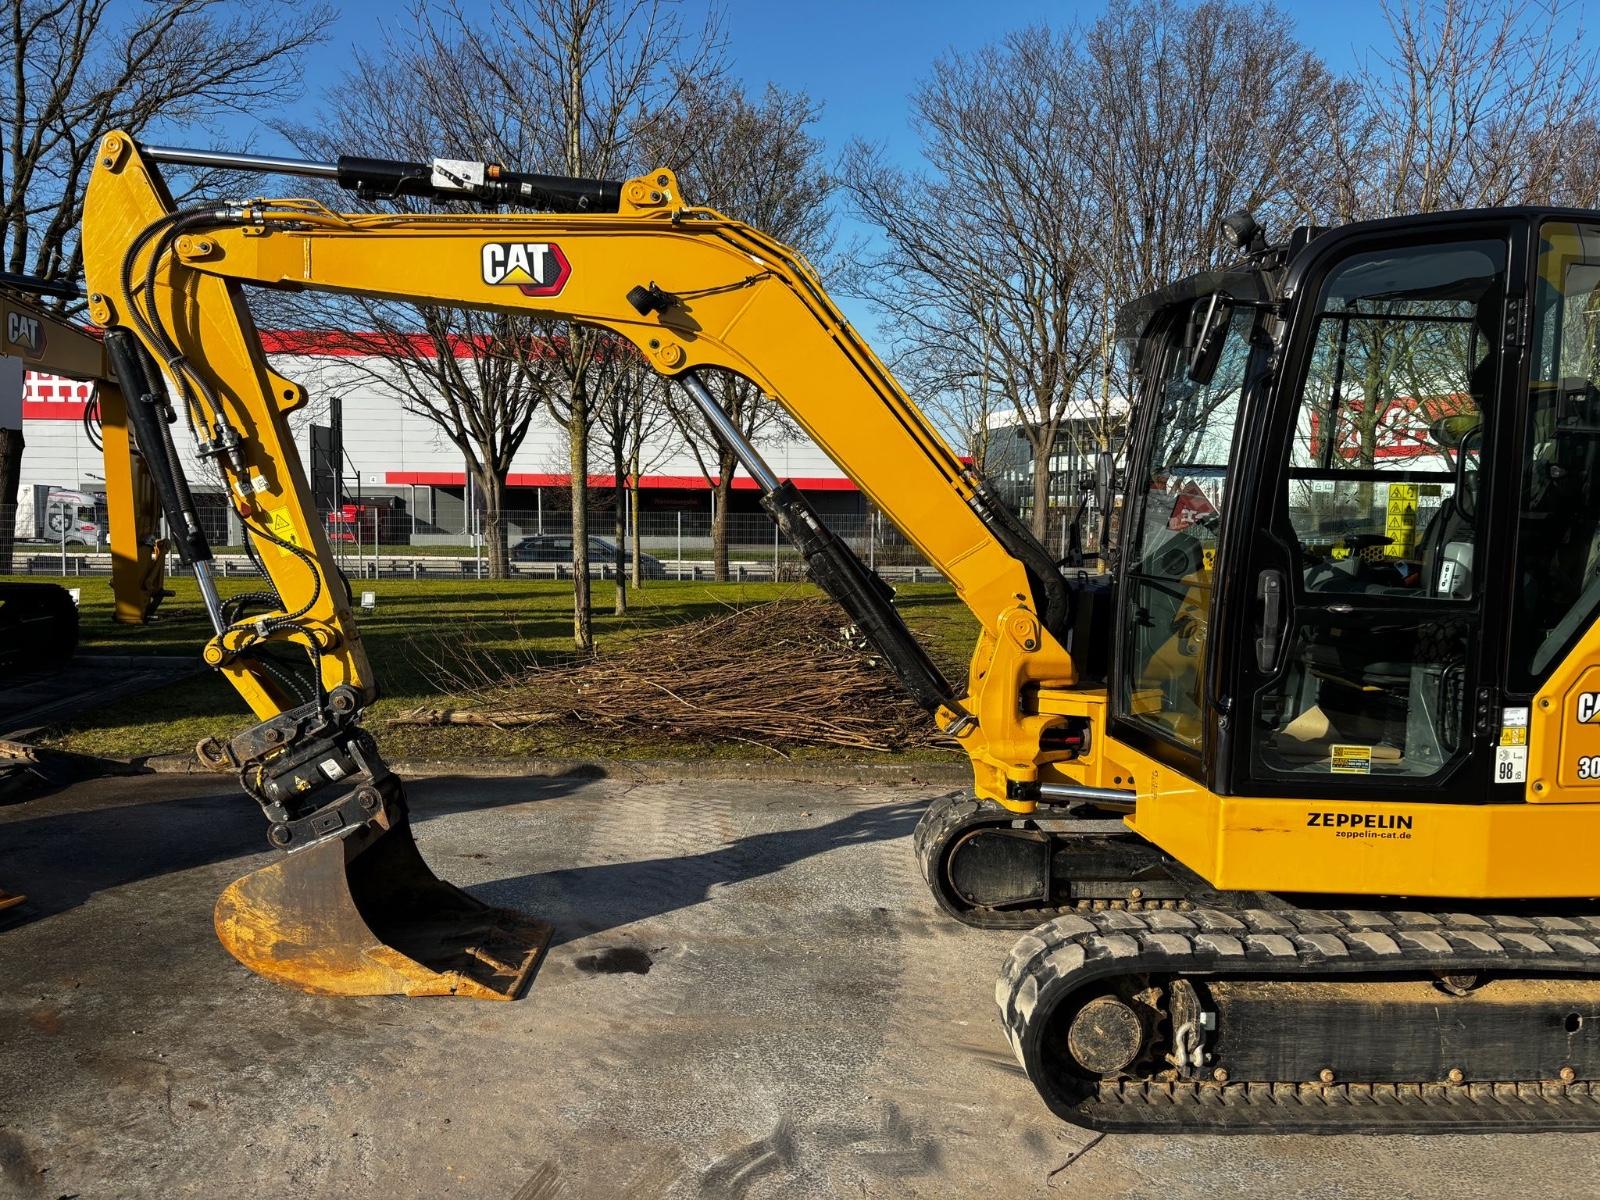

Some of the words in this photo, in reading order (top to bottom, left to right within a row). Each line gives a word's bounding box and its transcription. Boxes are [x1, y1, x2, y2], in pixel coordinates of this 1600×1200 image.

[483, 243, 549, 284] CAT
[8, 312, 38, 349] CAT
[1499, 762, 1513, 779] 98
[1307, 813, 1412, 829] ZEPPELIN
[1335, 830, 1412, 839] zeppelin-cat.de
